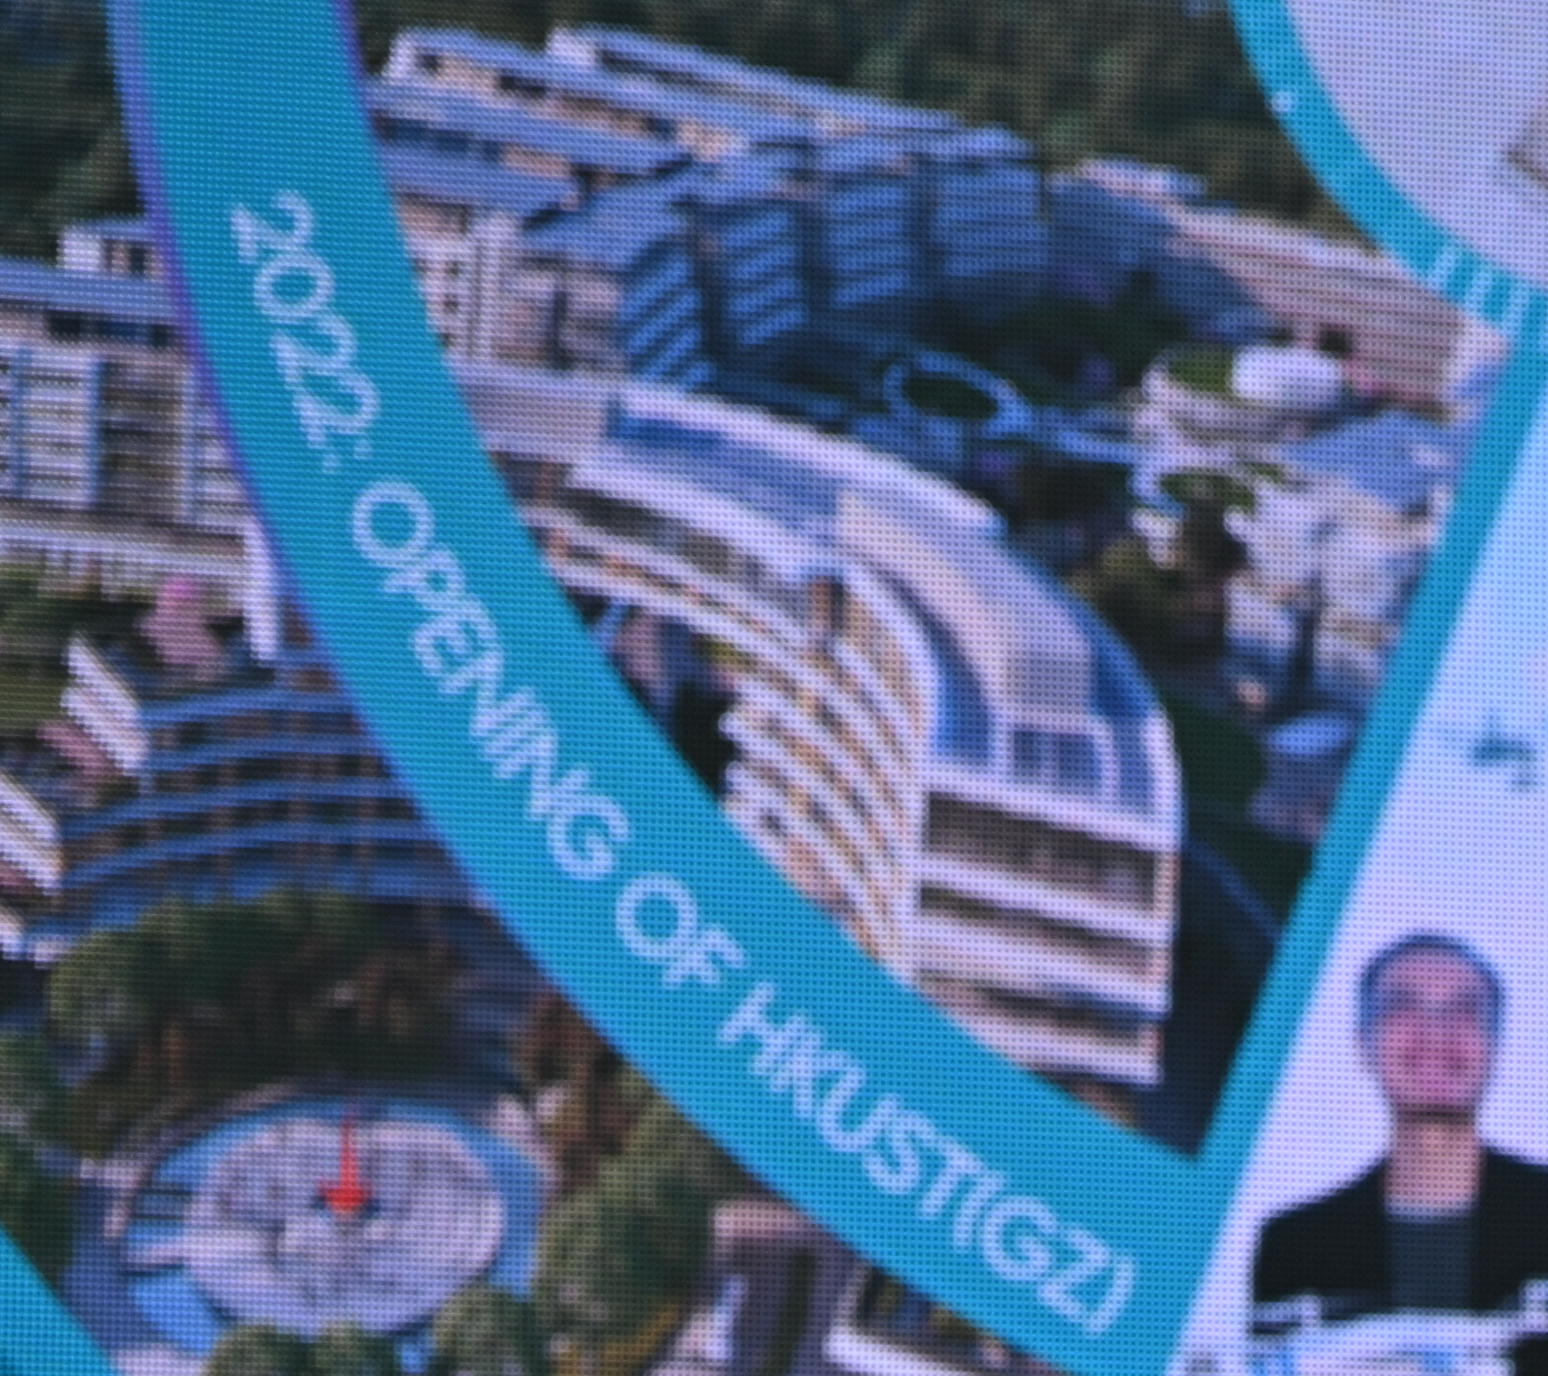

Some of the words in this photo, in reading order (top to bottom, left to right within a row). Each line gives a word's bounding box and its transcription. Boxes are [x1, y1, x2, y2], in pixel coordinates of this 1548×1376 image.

[230, 189, 382, 474] 2022:
[352, 481, 631, 881] OPENING
[615, 872, 748, 989] OF
[719, 981, 1138, 1337] HKUST(GZ)
